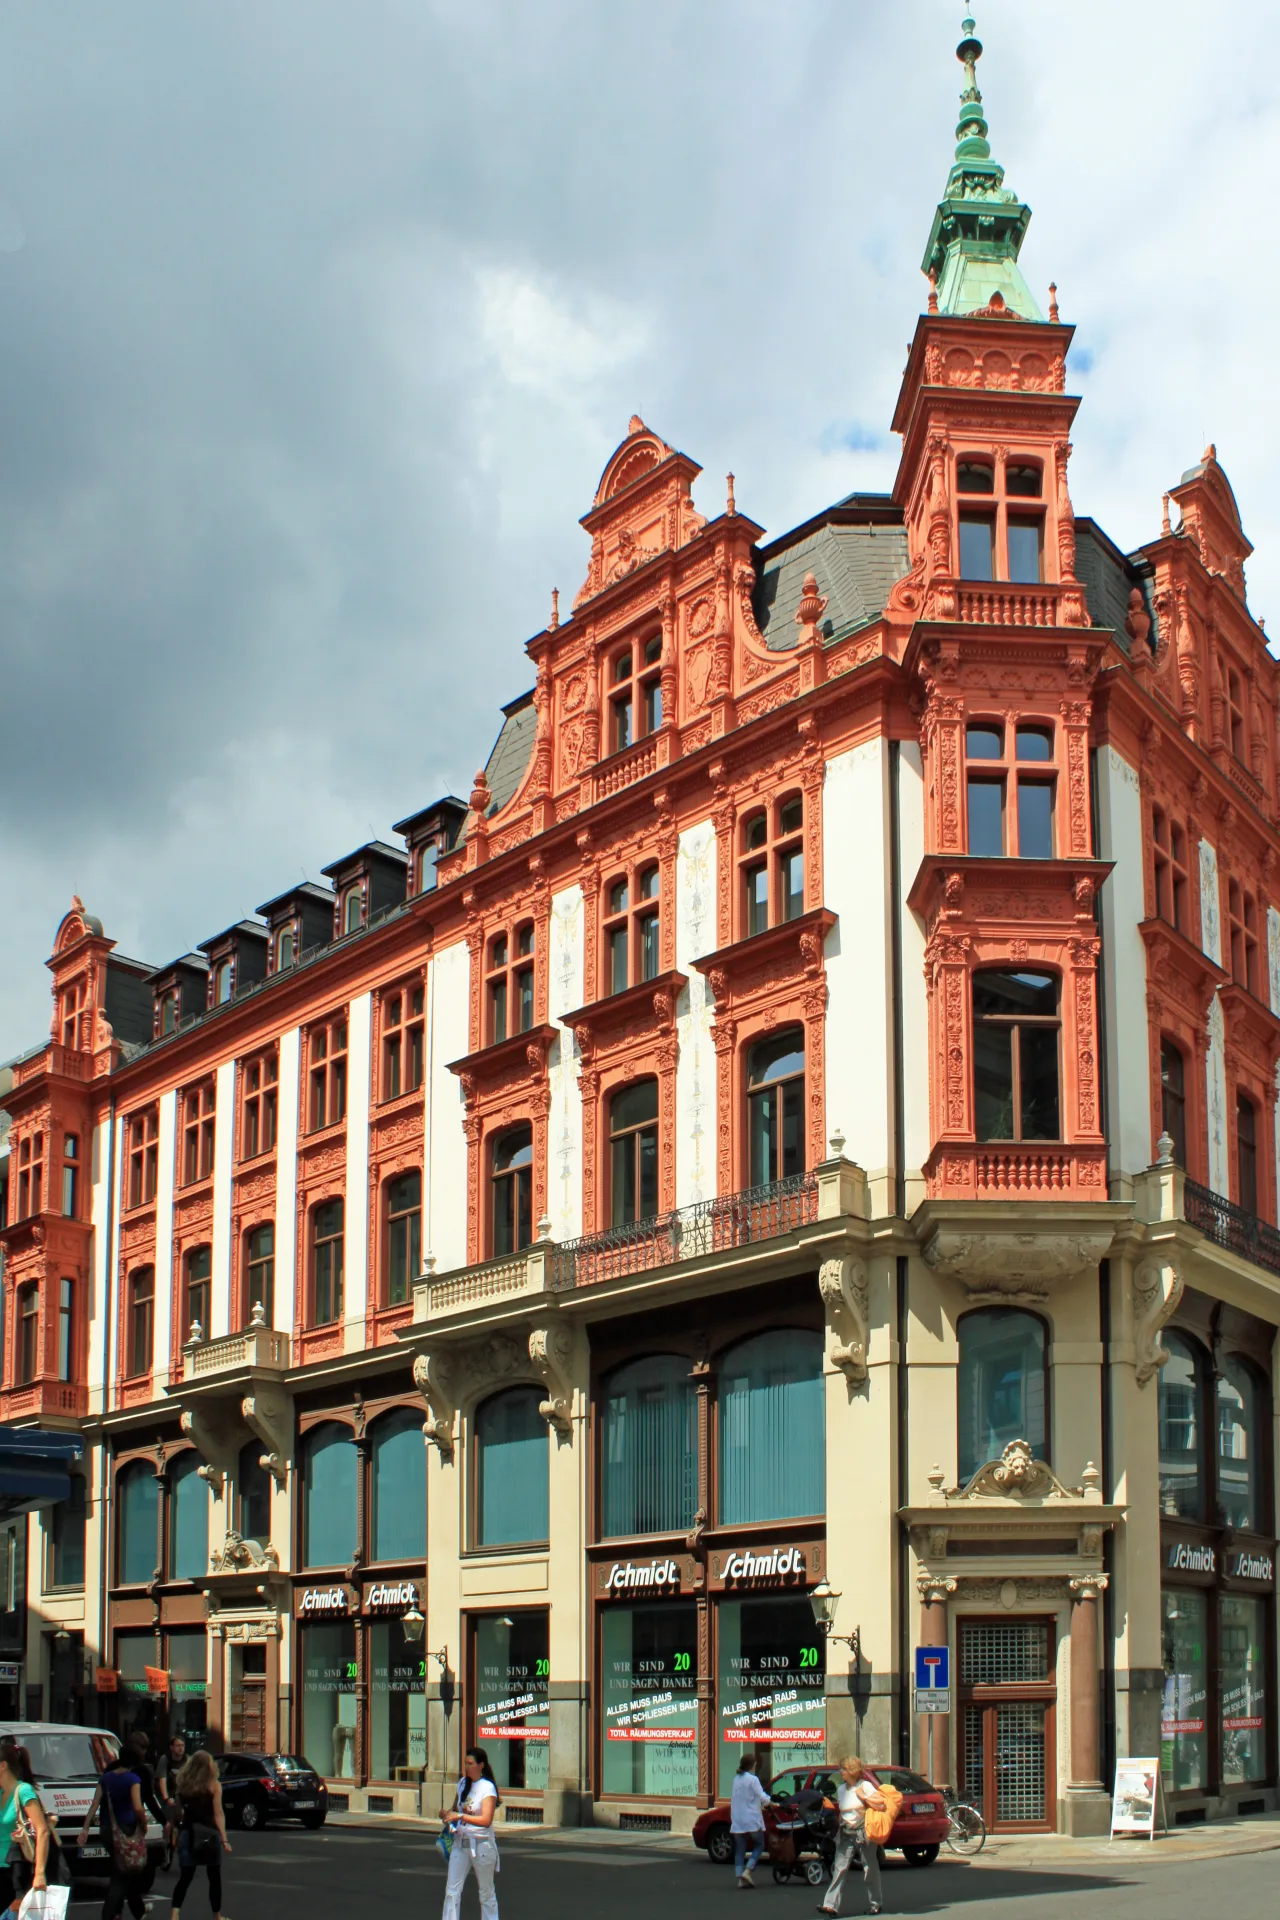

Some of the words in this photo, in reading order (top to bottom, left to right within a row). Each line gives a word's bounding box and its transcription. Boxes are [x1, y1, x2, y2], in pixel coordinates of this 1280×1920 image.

[720, 1547, 802, 1579] Schmidt
[1173, 1543, 1215, 1572] Schmidt
[1236, 1553, 1272, 1580] Schmidt
[605, 1559, 677, 1588] Schmidt
[299, 1587, 345, 1610] Schmidt
[365, 1582, 415, 1606] Schmidt
[484, 1666, 499, 1676] WIR
[506, 1666, 528, 1676] SIND
[535, 1659, 549, 1676] 20
[613, 1662, 631, 1672] WIR
[639, 1660, 665, 1672] SIND
[674, 1652, 691, 1671] 20
[731, 1658, 750, 1669] WIR
[760, 1656, 789, 1668] SIND
[799, 1647, 818, 1667] 20
[307, 1669, 319, 1677] WIR
[324, 1669, 341, 1677] SIND
[347, 1662, 357, 1677] 20
[374, 1667, 388, 1677] WIR
[394, 1667, 412, 1676] SIND
[418, 1661, 426, 1676] 2
[371, 1682, 387, 1691] UND
[388, 1681, 408, 1691] SAGEN
[410, 1681, 425, 1690] DAN
[481, 1682, 497, 1692] UND
[499, 1681, 524, 1691] SAGEN
[526, 1681, 548, 1691] DANK
[610, 1678, 628, 1688] UND
[631, 1677, 659, 1688] SAGEN
[662, 1677, 694, 1688] DANKE
[726, 1676, 747, 1686] UND
[750, 1675, 783, 1686] SAGEN
[786, 1674, 823, 1685] DANKE
[477, 1703, 496, 1715] ALLES
[497, 1698, 515, 1710] MUSS
[516, 1693, 534, 1705] RAUS
[606, 1703, 628, 1716] ALLES
[630, 1697, 650, 1711] MUSS
[652, 1691, 672, 1705] RAUS
[616, 1715, 631, 1726] WIR
[632, 1704, 677, 1723] SCHLIESSEN
[679, 1698, 698, 1712] BALD
[722, 1702, 747, 1716] ALLES
[749, 1696, 773, 1710] MUSS
[774, 1689, 797, 1703] RAUS
[486, 1715, 499, 1725] WIR
[499, 1704, 538, 1722] SCHLIESSEN
[734, 1715, 750, 1726] WIR
[752, 1703, 803, 1723] SCHLIESSEN
[481, 1728, 497, 1736] TOTAL
[498, 1727, 549, 1736] RÄUMUNGSVERKAU
[610, 1729, 628, 1737] TOTAL
[630, 1728, 694, 1738] RÄUMUNGSVERKAUF
[727, 1730, 747, 1738] TOTAL
[749, 1728, 822, 1739] RÄUMUNGSVERKAUF
[53, 1793, 67, 1801] DIE
